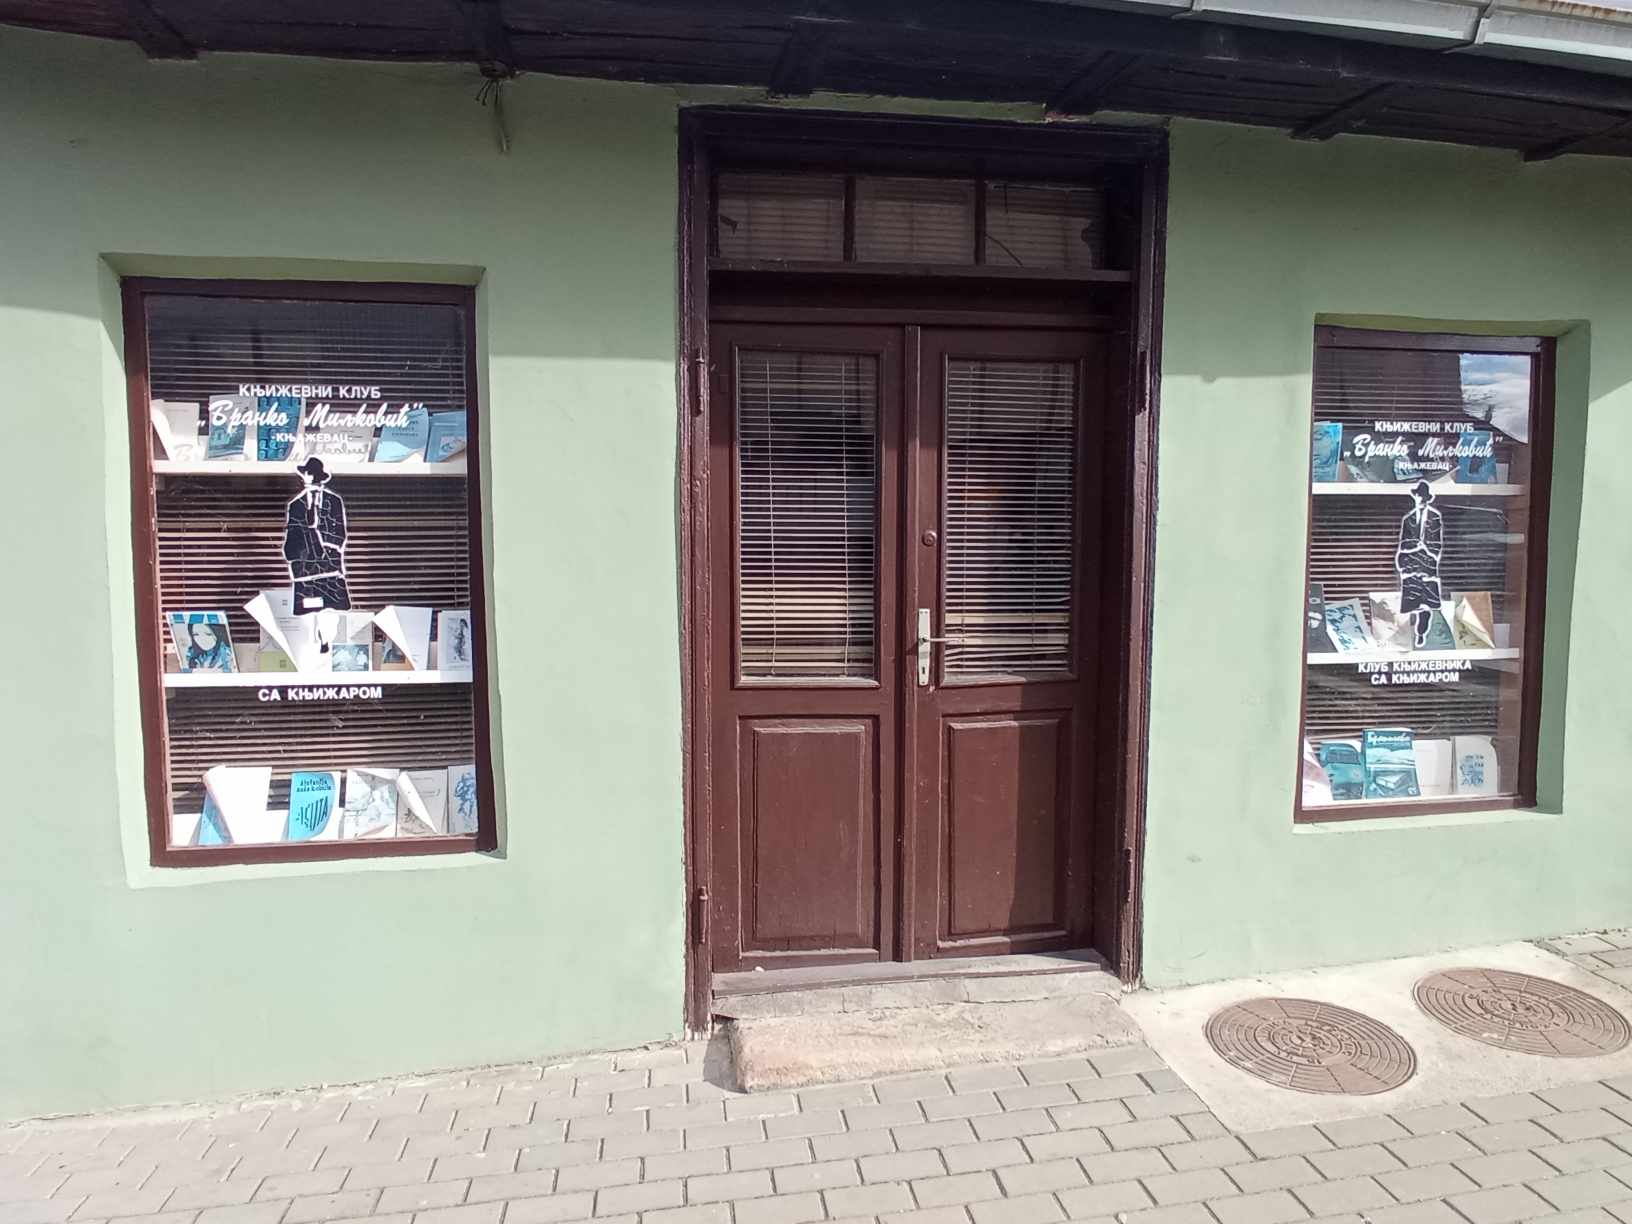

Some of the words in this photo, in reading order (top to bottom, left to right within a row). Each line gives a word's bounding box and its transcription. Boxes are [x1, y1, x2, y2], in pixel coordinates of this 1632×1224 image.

[239, 384, 333, 398] КЊИЖЕВНИ
[339, 386, 381, 399] КЛУБ
[1374, 421, 1440, 432] КЊИЖЕВНИ
[1444, 422, 1475, 433] КЛУБ
[1358, 662, 1389, 673] КЛУБ
[1393, 660, 1472, 672] КЊИЖЕВНИКА
[1371, 673, 1388, 685] СА
[1392, 671, 1460, 684] КЊИЖАРОМ
[258, 688, 281, 702] СА
[287, 686, 383, 701] КЊИЖАРОМ
